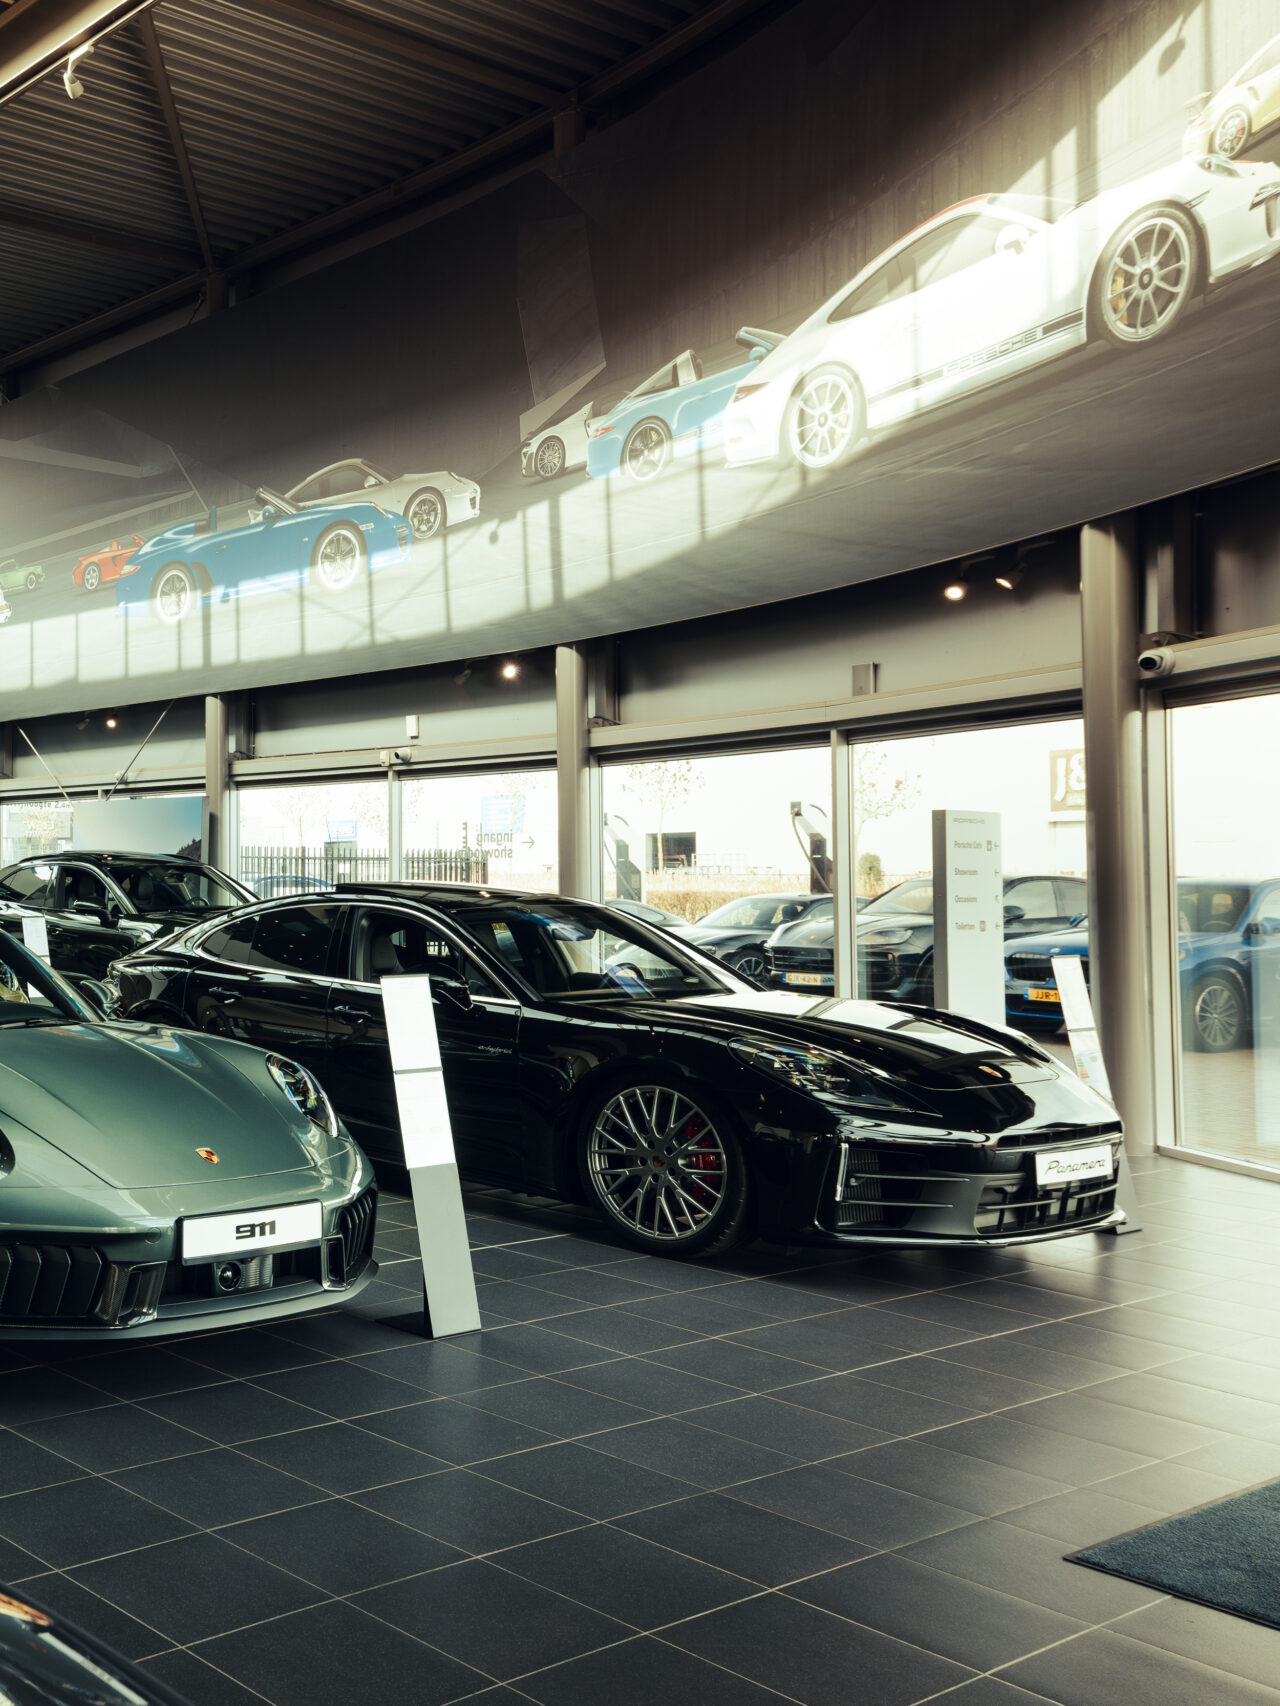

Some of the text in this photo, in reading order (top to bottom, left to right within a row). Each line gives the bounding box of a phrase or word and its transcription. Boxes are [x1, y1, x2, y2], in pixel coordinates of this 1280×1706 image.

[1035, 990, 1060, 1001] JJR-1
[1044, 1159, 1106, 1176] Panamera
[235, 1220, 276, 1240] 911
